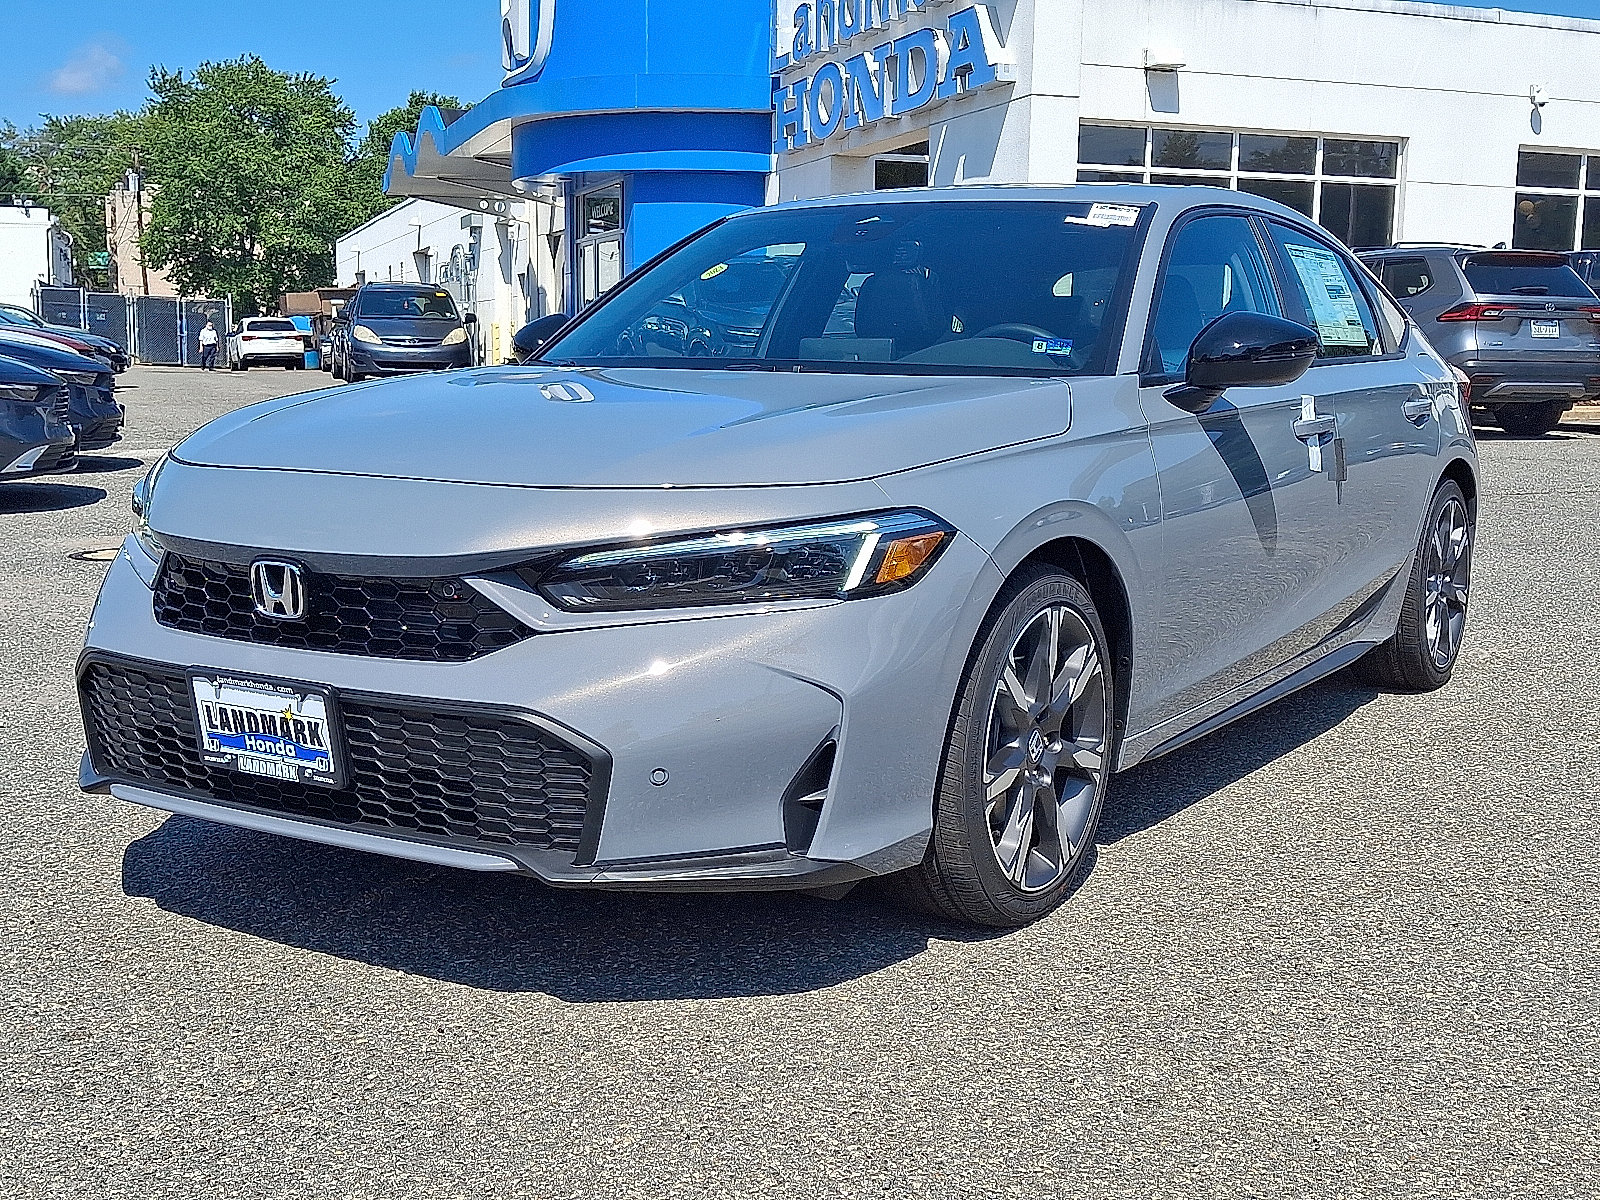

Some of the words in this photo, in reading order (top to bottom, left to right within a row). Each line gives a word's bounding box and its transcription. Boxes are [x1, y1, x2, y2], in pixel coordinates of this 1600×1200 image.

[770, 0, 926, 74] Landm
[772, 4, 1000, 153] HONDA
[591, 201, 614, 219] WELCOME
[204, 703, 325, 748] LANDMARK
[244, 735, 297, 757] Honda
[239, 756, 298, 780] LANDMARK
